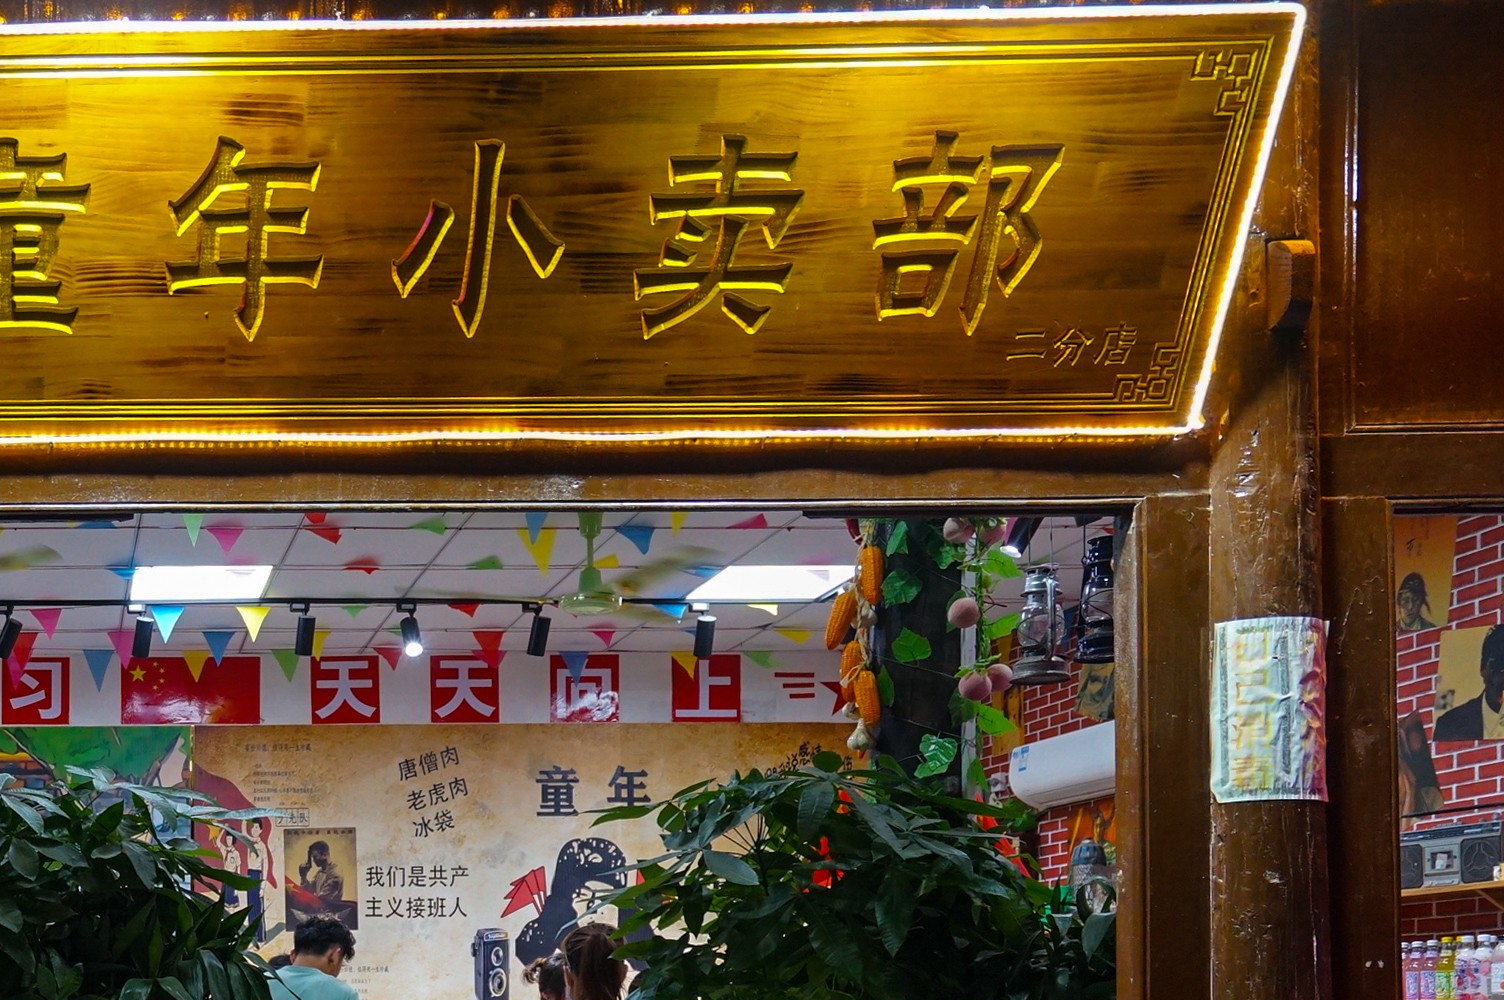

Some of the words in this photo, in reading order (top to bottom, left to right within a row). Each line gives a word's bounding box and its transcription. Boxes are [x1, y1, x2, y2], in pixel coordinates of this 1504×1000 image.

[1005, 325, 1138, 370] 二分店
[316, 658, 739, 722] 天天向上
[397, 745, 461, 781] 唐僧肉
[406, 775, 470, 811] 老虎肉
[535, 765, 652, 817] 童年
[412, 813, 456, 839] 冰袋
[364, 865, 470, 888] 我们是共产
[364, 897, 468, 919] 主义接班人
